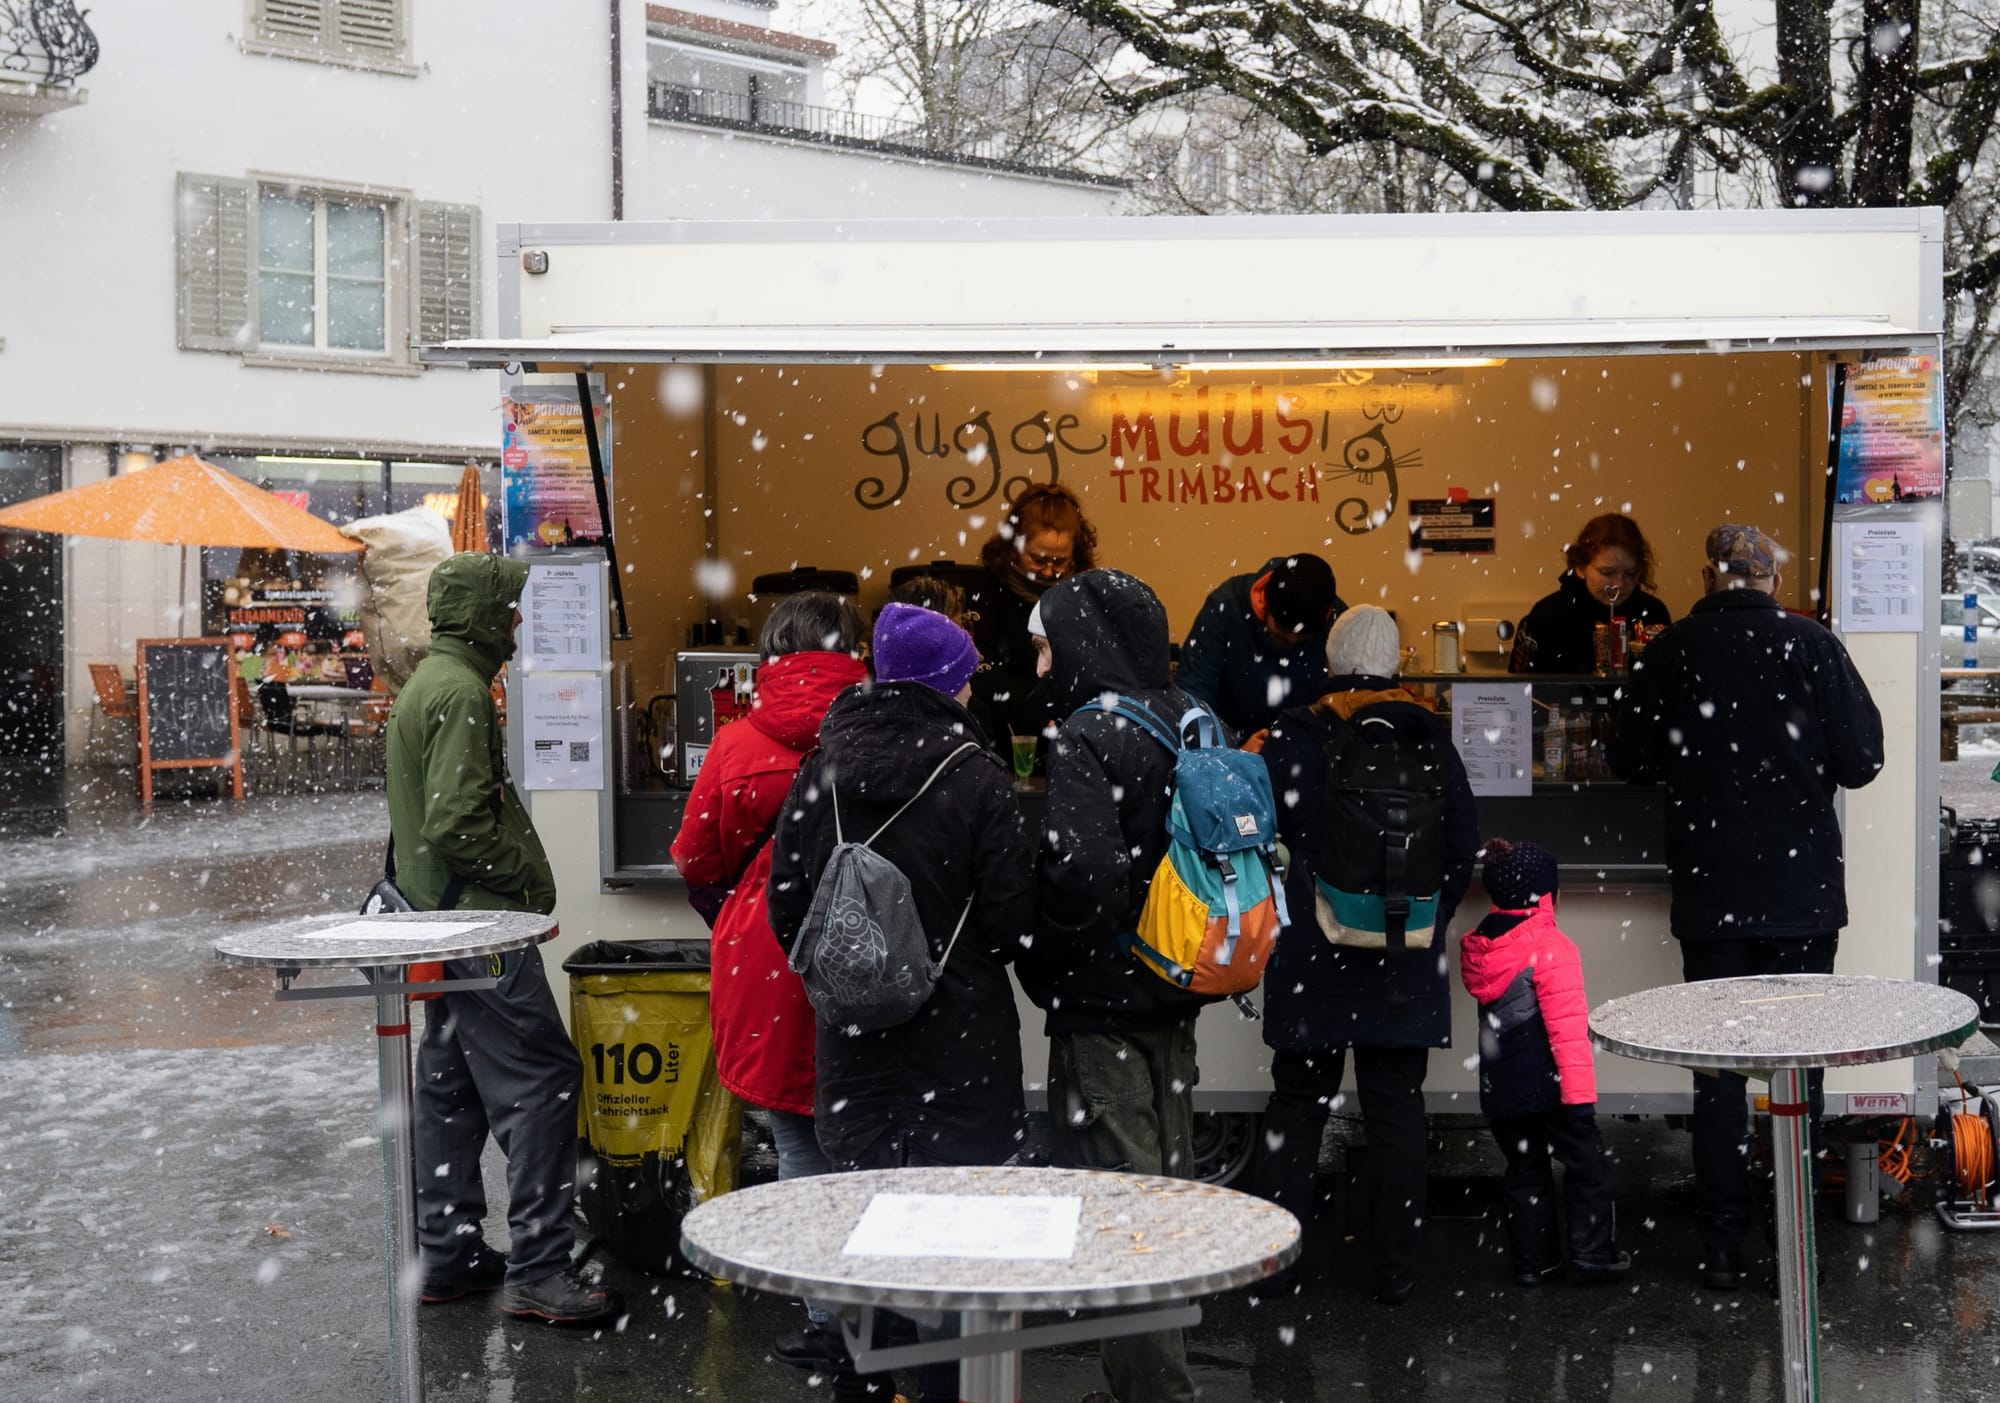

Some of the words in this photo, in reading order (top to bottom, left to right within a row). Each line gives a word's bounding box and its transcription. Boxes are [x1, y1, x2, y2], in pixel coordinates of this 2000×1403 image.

[1110, 463, 1319, 505] TRIMBACH
[591, 1042, 662, 1085] 110
[665, 1042, 679, 1083] Liter
[597, 1092, 650, 1104] Offizieller
[1853, 1096, 1899, 1108] Wenk
